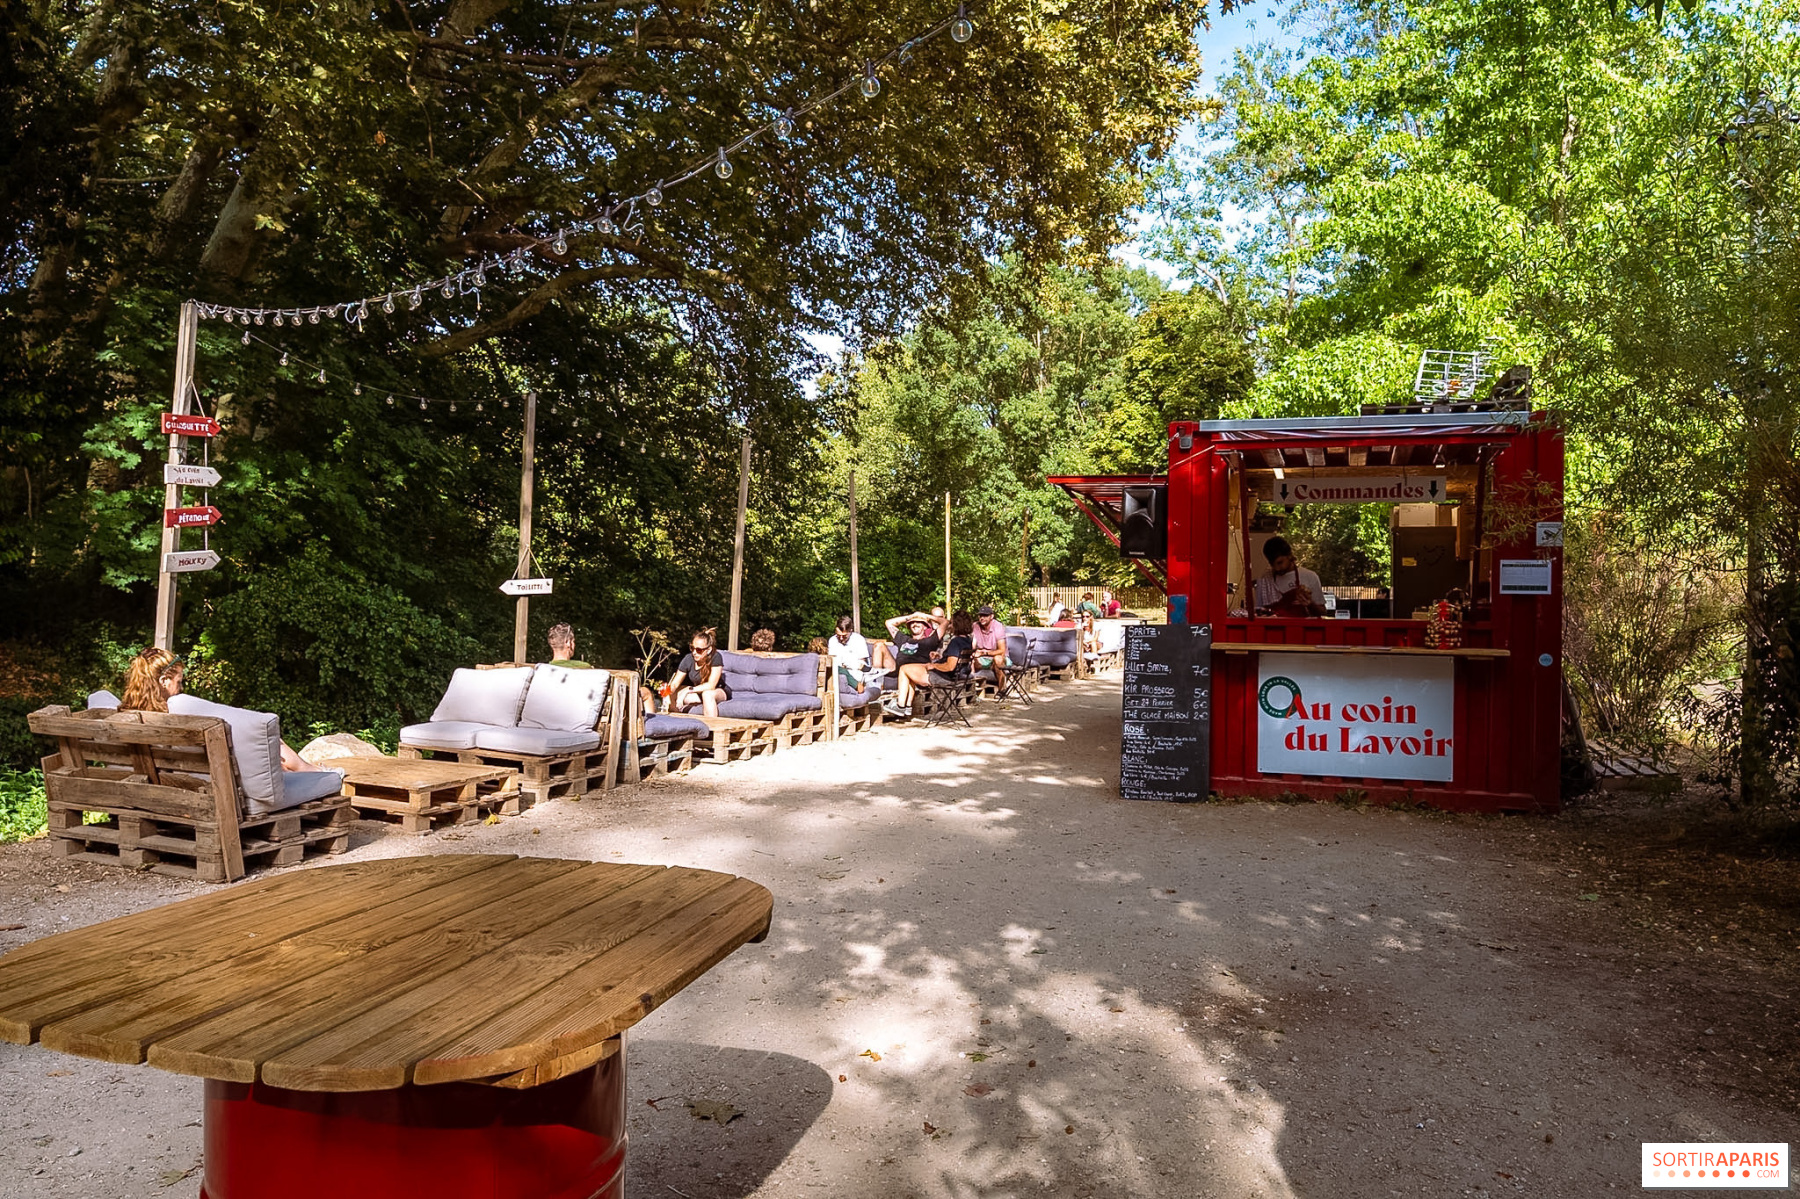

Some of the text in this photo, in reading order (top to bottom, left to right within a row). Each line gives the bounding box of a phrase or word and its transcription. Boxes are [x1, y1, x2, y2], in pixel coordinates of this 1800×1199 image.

[1294, 482, 1424, 500] Commandes
[1190, 626, 1208, 637] 7€
[1191, 665, 1209, 676] 7€
[1193, 688, 1209, 699] 5€
[1193, 700, 1208, 710] 6€
[1285, 693, 1418, 724] Au coin
[1193, 711, 1209, 720] 2€
[1284, 724, 1454, 757] du Lavoir
